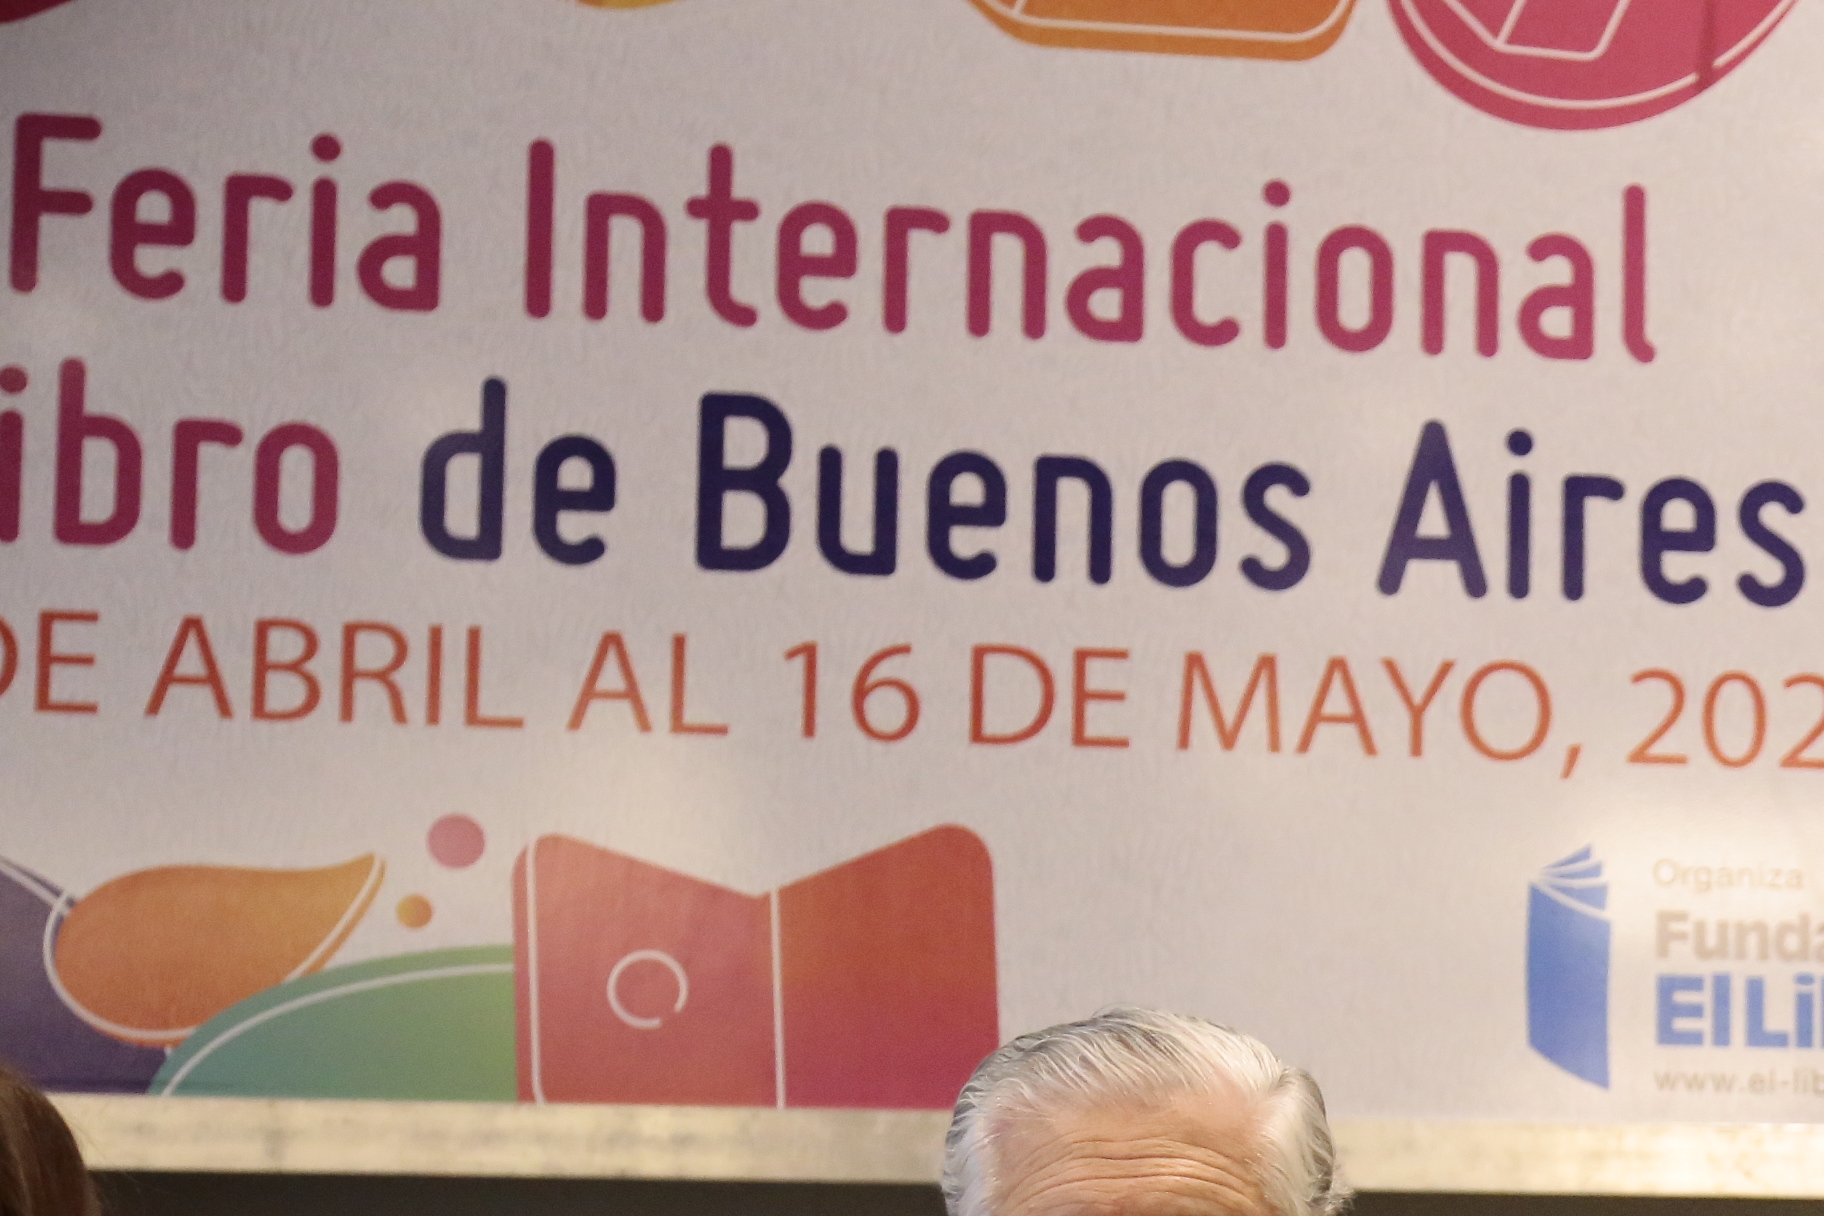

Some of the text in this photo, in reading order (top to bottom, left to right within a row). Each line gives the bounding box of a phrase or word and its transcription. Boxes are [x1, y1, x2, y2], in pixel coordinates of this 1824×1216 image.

[9, 111, 1656, 365] Feria Internacional
[419, 377, 616, 565] de
[695, 391, 1310, 591] Buenos
[1378, 419, 1805, 608] Aires
[0, 609, 100, 714] E
[144, 614, 524, 729] ABRIL
[566, 630, 729, 736] AL
[783, 641, 922, 744] 16
[968, 643, 1131, 749] DE
[1176, 650, 1583, 780] MAYO,
[1652, 857, 1805, 893] Organiza
